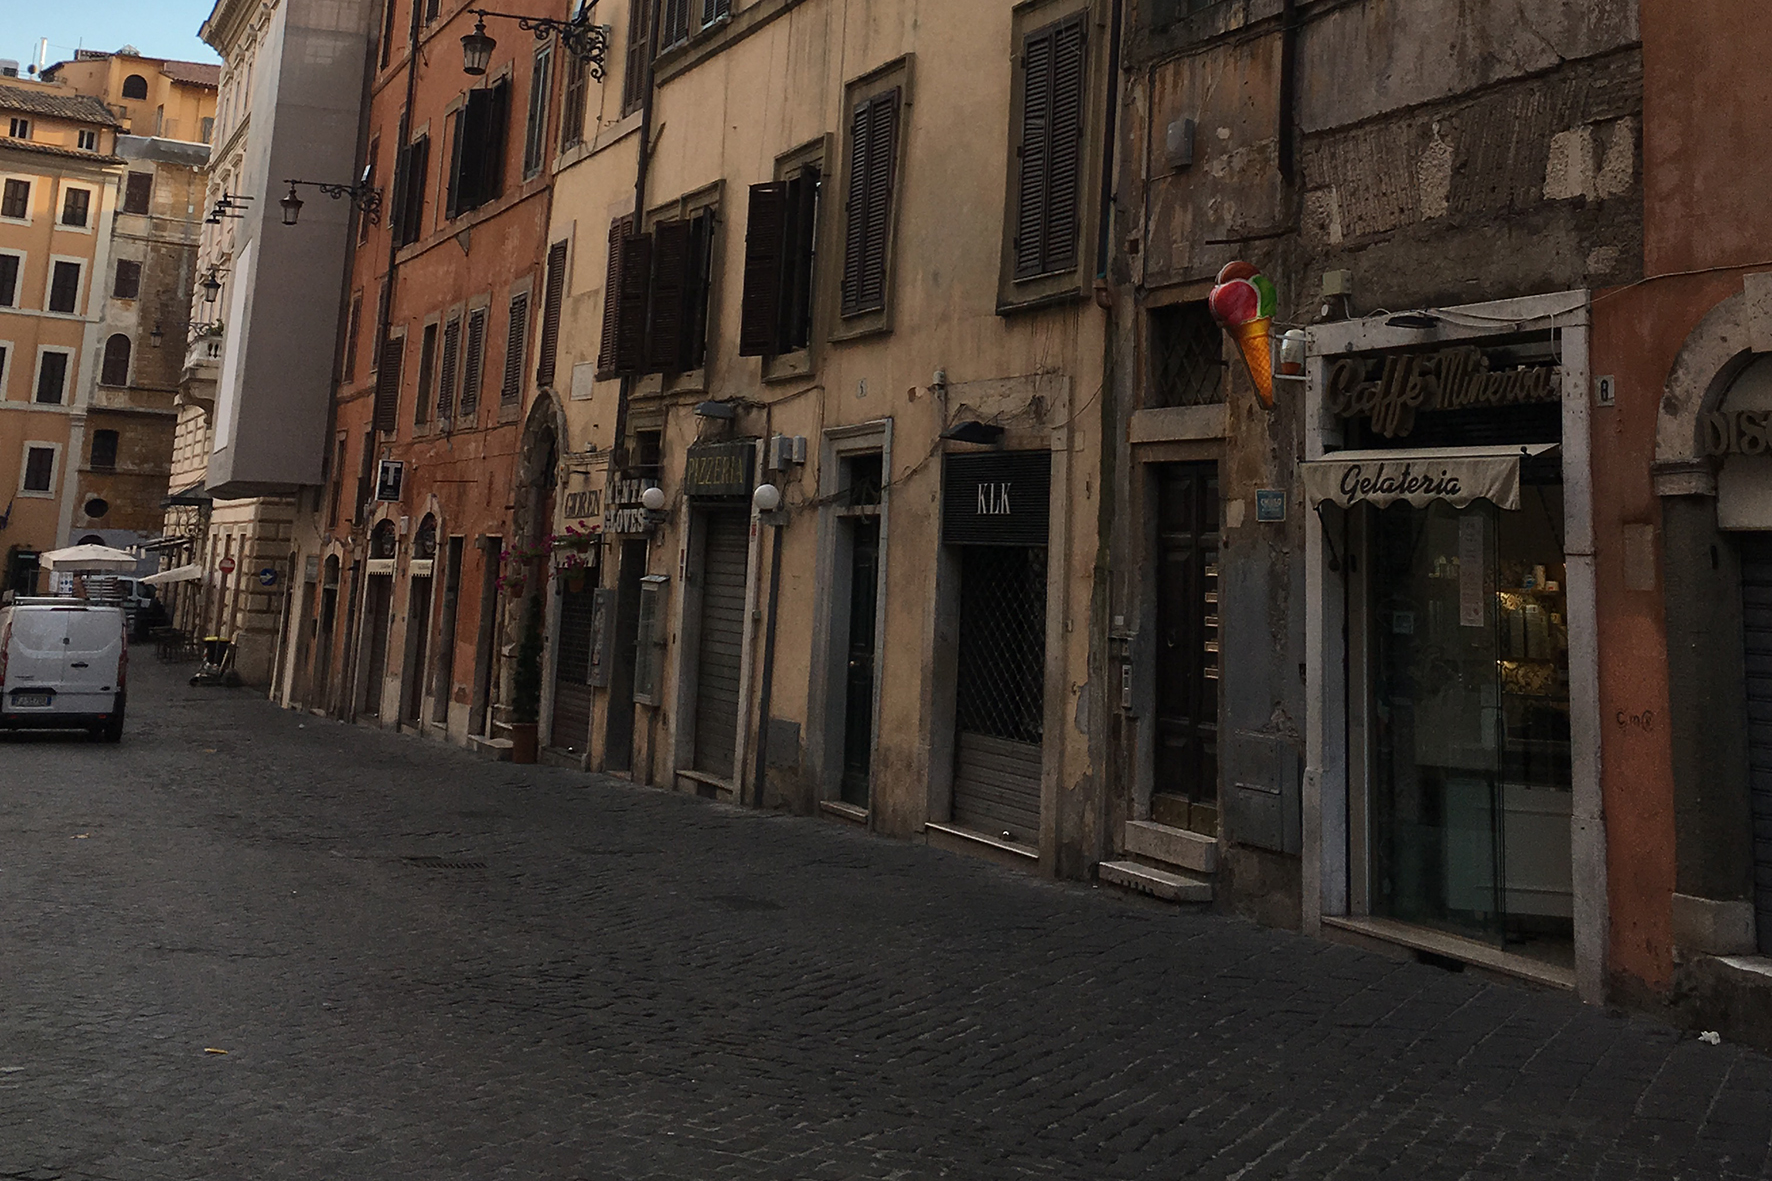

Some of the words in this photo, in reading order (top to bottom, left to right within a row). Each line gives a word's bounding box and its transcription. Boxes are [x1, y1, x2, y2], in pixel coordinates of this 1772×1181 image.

[1434, 347, 1551, 409] Minerva
[1702, 410, 1772, 457] DIS
[383, 461, 402, 486] T
[687, 455, 744, 485] PIZZERIA
[1340, 463, 1461, 506] Gelateria
[976, 482, 1012, 515] KLK
[604, 507, 646, 533] GLOVES
